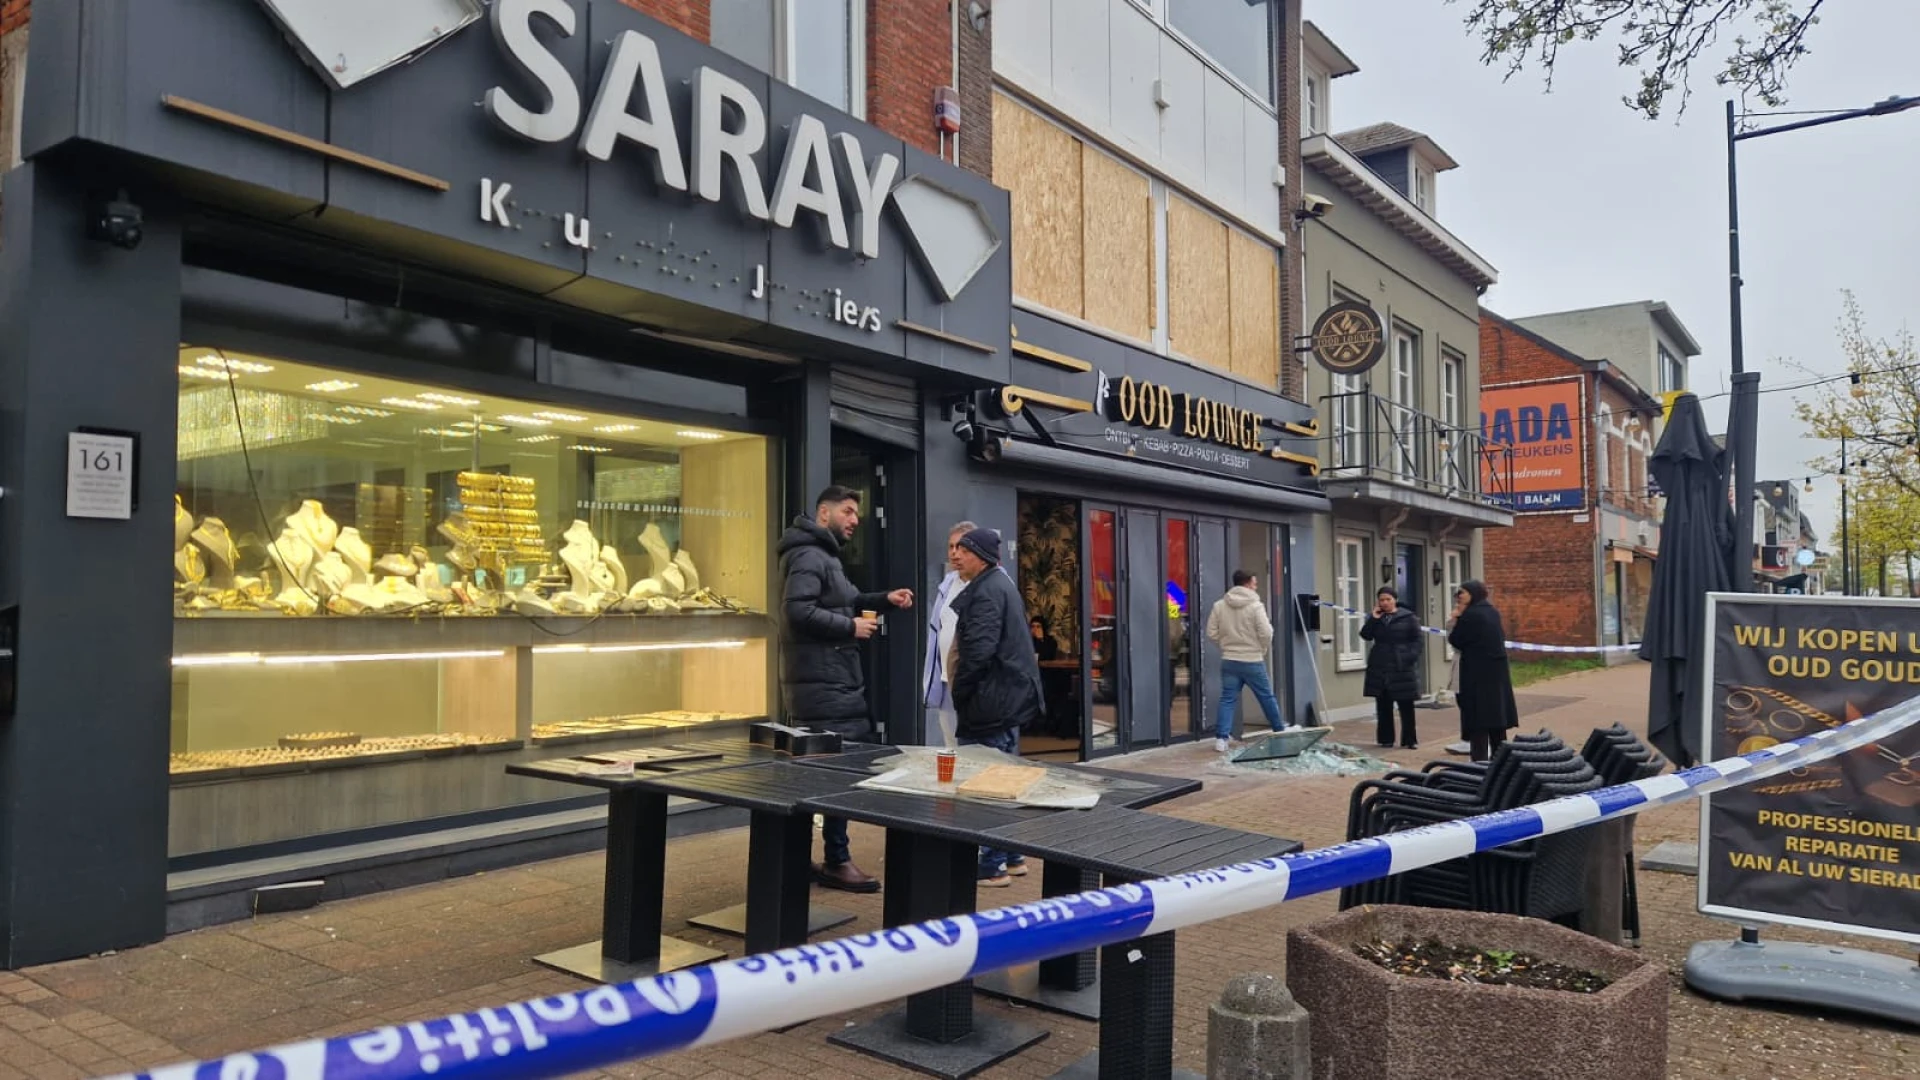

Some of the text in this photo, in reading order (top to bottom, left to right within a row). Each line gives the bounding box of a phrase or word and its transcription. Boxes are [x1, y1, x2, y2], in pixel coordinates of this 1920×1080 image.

[485, 0, 900, 259] SARAY
[1184, 393, 1265, 452] LOUNGE
[80, 449, 122, 472] 161
[1734, 625, 1786, 648] WIJ
[1798, 628, 1897, 653] KOPEN
[1768, 655, 1920, 683] OUD GOUD
[1786, 836, 1900, 863] REPARATIE
[1728, 851, 1772, 872] VAN
[1776, 858, 1804, 876] AL
[1808, 862, 1845, 881] UW
[350, 984, 632, 1074] Politie
